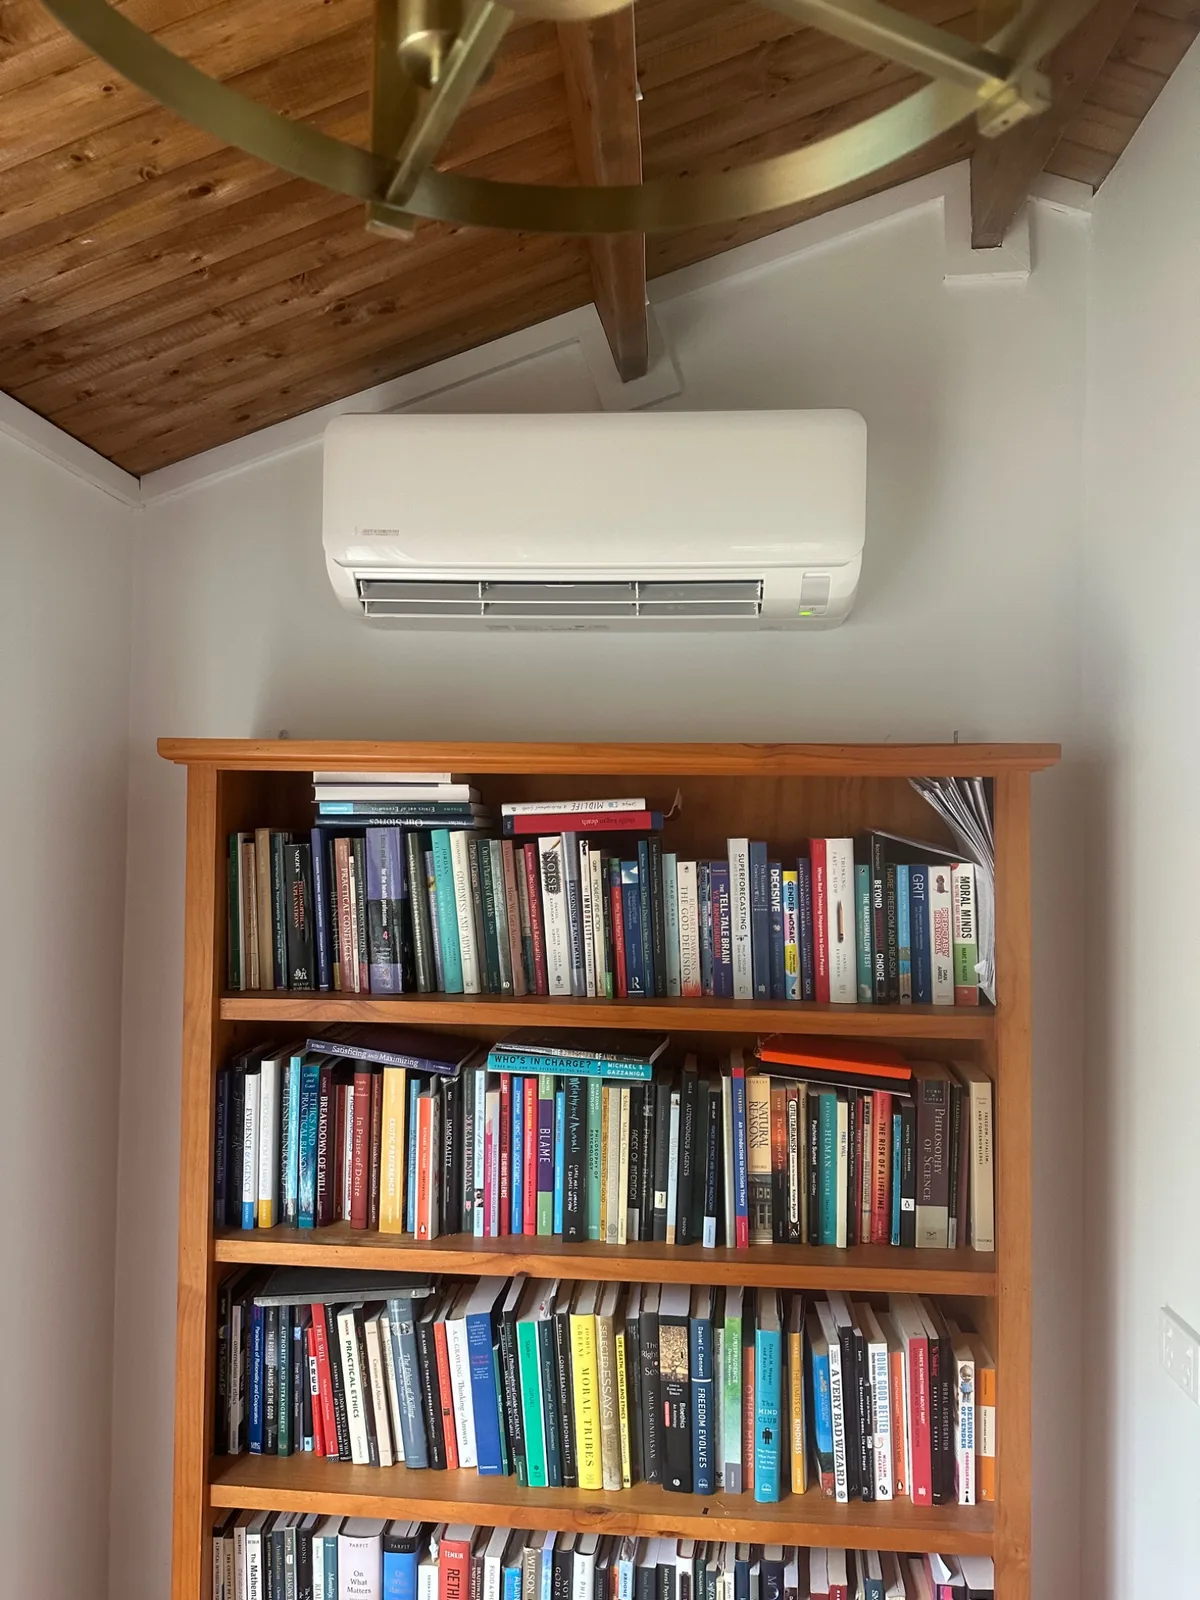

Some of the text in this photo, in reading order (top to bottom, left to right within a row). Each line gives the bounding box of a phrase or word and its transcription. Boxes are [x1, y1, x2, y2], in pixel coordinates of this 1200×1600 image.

[571, 801, 604, 811] MIDLIFE
[341, 868, 350, 912] PRACTICAL
[546, 852, 558, 891] NOISE
[737, 853, 747, 930] SUPERFORECASTING
[770, 869, 781, 912] DECISIVE
[912, 873, 925, 901] GRIT
[719, 893, 729, 937] TELL-TALE
[787, 880, 796, 944] GENDER MOSAIC
[874, 879, 882, 908] BEYOND
[959, 876, 972, 939] MORAL MINDS
[343, 914, 352, 961] CONFLICTS
[456, 870, 472, 962] GOODNESS AND ADVICE
[681, 887, 692, 984] THE GOD DELUSION
[863, 905, 871, 952] MARSHMALLOW
[886, 868, 896, 978] HARE FREEDOM AND REASON
[934, 910, 942, 954] IRRATIONAL
[940, 907, 950, 958] PREDICTABLY
[721, 938, 730, 964] BRAIN
[876, 953, 885, 981] CHOICE
[331, 1045, 367, 1058] Satisficing
[379, 1053, 419, 1067] Maximizing
[494, 1055, 592, 1069] WHO'S IN CHARGE?
[607, 1069, 645, 1077] GAZZANIGA
[608, 1062, 636, 1070] MICHAEL
[308, 1092, 317, 1146] ETHICS AND
[683, 1103, 692, 1176] AUTONOMOUS AGENTS
[738, 1121, 744, 1129] An
[748, 1101, 759, 1148] REASONS
[758, 1101, 769, 1148] NATURAL
[789, 1104, 797, 1154] UTILITARIANISM
[878, 1122, 887, 1135] THE
[318, 1096, 328, 1192] BREAKDOWN OF WILL
[354, 1116, 364, 1197] In Praise of Desire
[445, 1119, 453, 1167] IMMORALITY
[465, 1114, 473, 1192] MORAL DILEMMAS
[539, 1128, 551, 1163] BLAME
[824, 1129, 832, 1167] HUMAN
[878, 1138, 887, 1156] RISK
[878, 1158, 886, 1167] OF
[933, 1108, 945, 1175] PHILOSOPHY
[923, 1139, 933, 1201] OF SCIENCE
[877, 1177, 886, 1211] LIFETIME
[315, 1324, 326, 1363] FREE WILL
[403, 1353, 411, 1365] The
[231, 1380, 239, 1388] on
[345, 1340, 359, 1418] PRACTICAL ETHICS
[404, 1367, 413, 1386] Ethics
[559, 1355, 567, 1404] CONVERSATION
[600, 1325, 613, 1418] SELECTED ESSAYS
[831, 1368, 839, 1377] A
[876, 1352, 888, 1434] DOING GOOD BETTER
[406, 1395, 416, 1418] Killing
[794, 1406, 801, 1417] OF
[832, 1379, 841, 1411] VERY
[961, 1406, 967, 1416] OF
[581, 1367, 594, 1467] MORAL TRIBES
[648, 1413, 656, 1459] SRINIVASAN
[697, 1388, 707, 1469] FREEDOM EVOLVES
[794, 1418, 802, 1454] KINDNESS
[833, 1413, 843, 1437] BAD
[562, 1415, 571, 1464] RESPONSIBILITY
[834, 1439, 846, 1487] WIZARD
[444, 1550, 464, 1559] TEMKIN
[526, 1555, 536, 1594] WILSON
[347, 1586, 371, 1594] Matters
[349, 1578, 368, 1586] What
